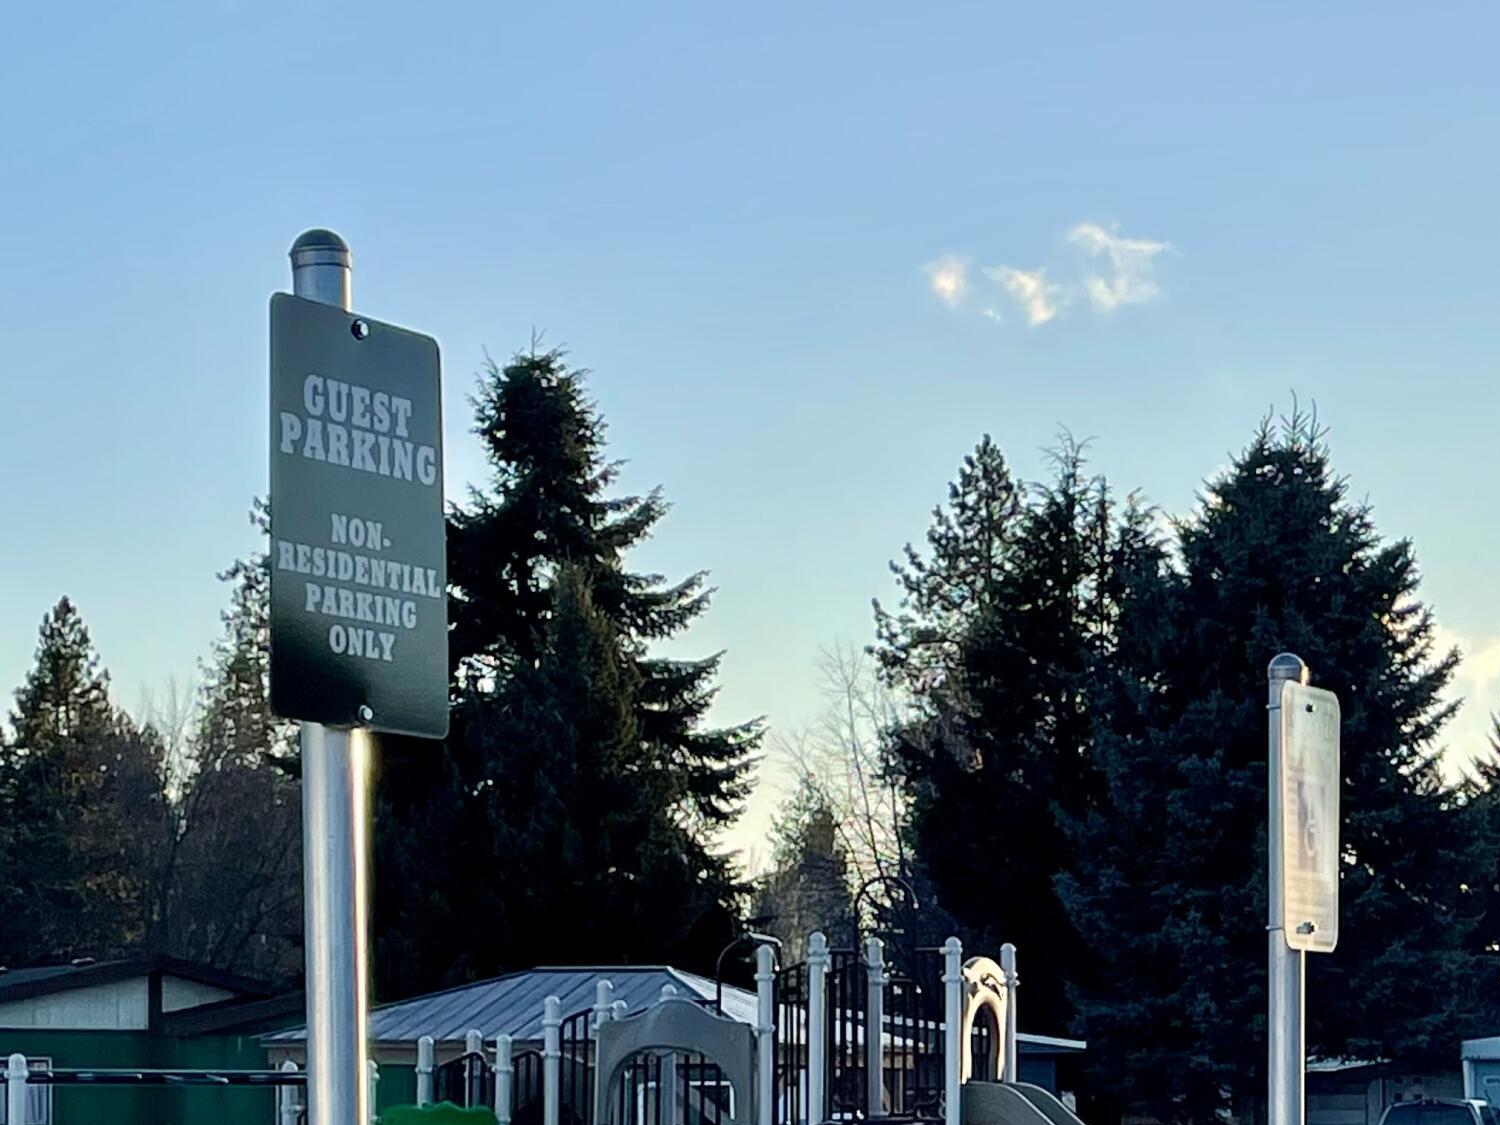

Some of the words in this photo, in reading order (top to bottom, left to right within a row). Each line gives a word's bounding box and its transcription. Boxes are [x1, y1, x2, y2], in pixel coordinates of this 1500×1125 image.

[303, 374, 412, 437] GUEST
[280, 412, 437, 486] PARKING
[331, 513, 391, 551] NON-
[278, 541, 441, 598] RESIDENTIAL
[305, 583, 417, 629] PARKING
[329, 625, 396, 662] ONLY
